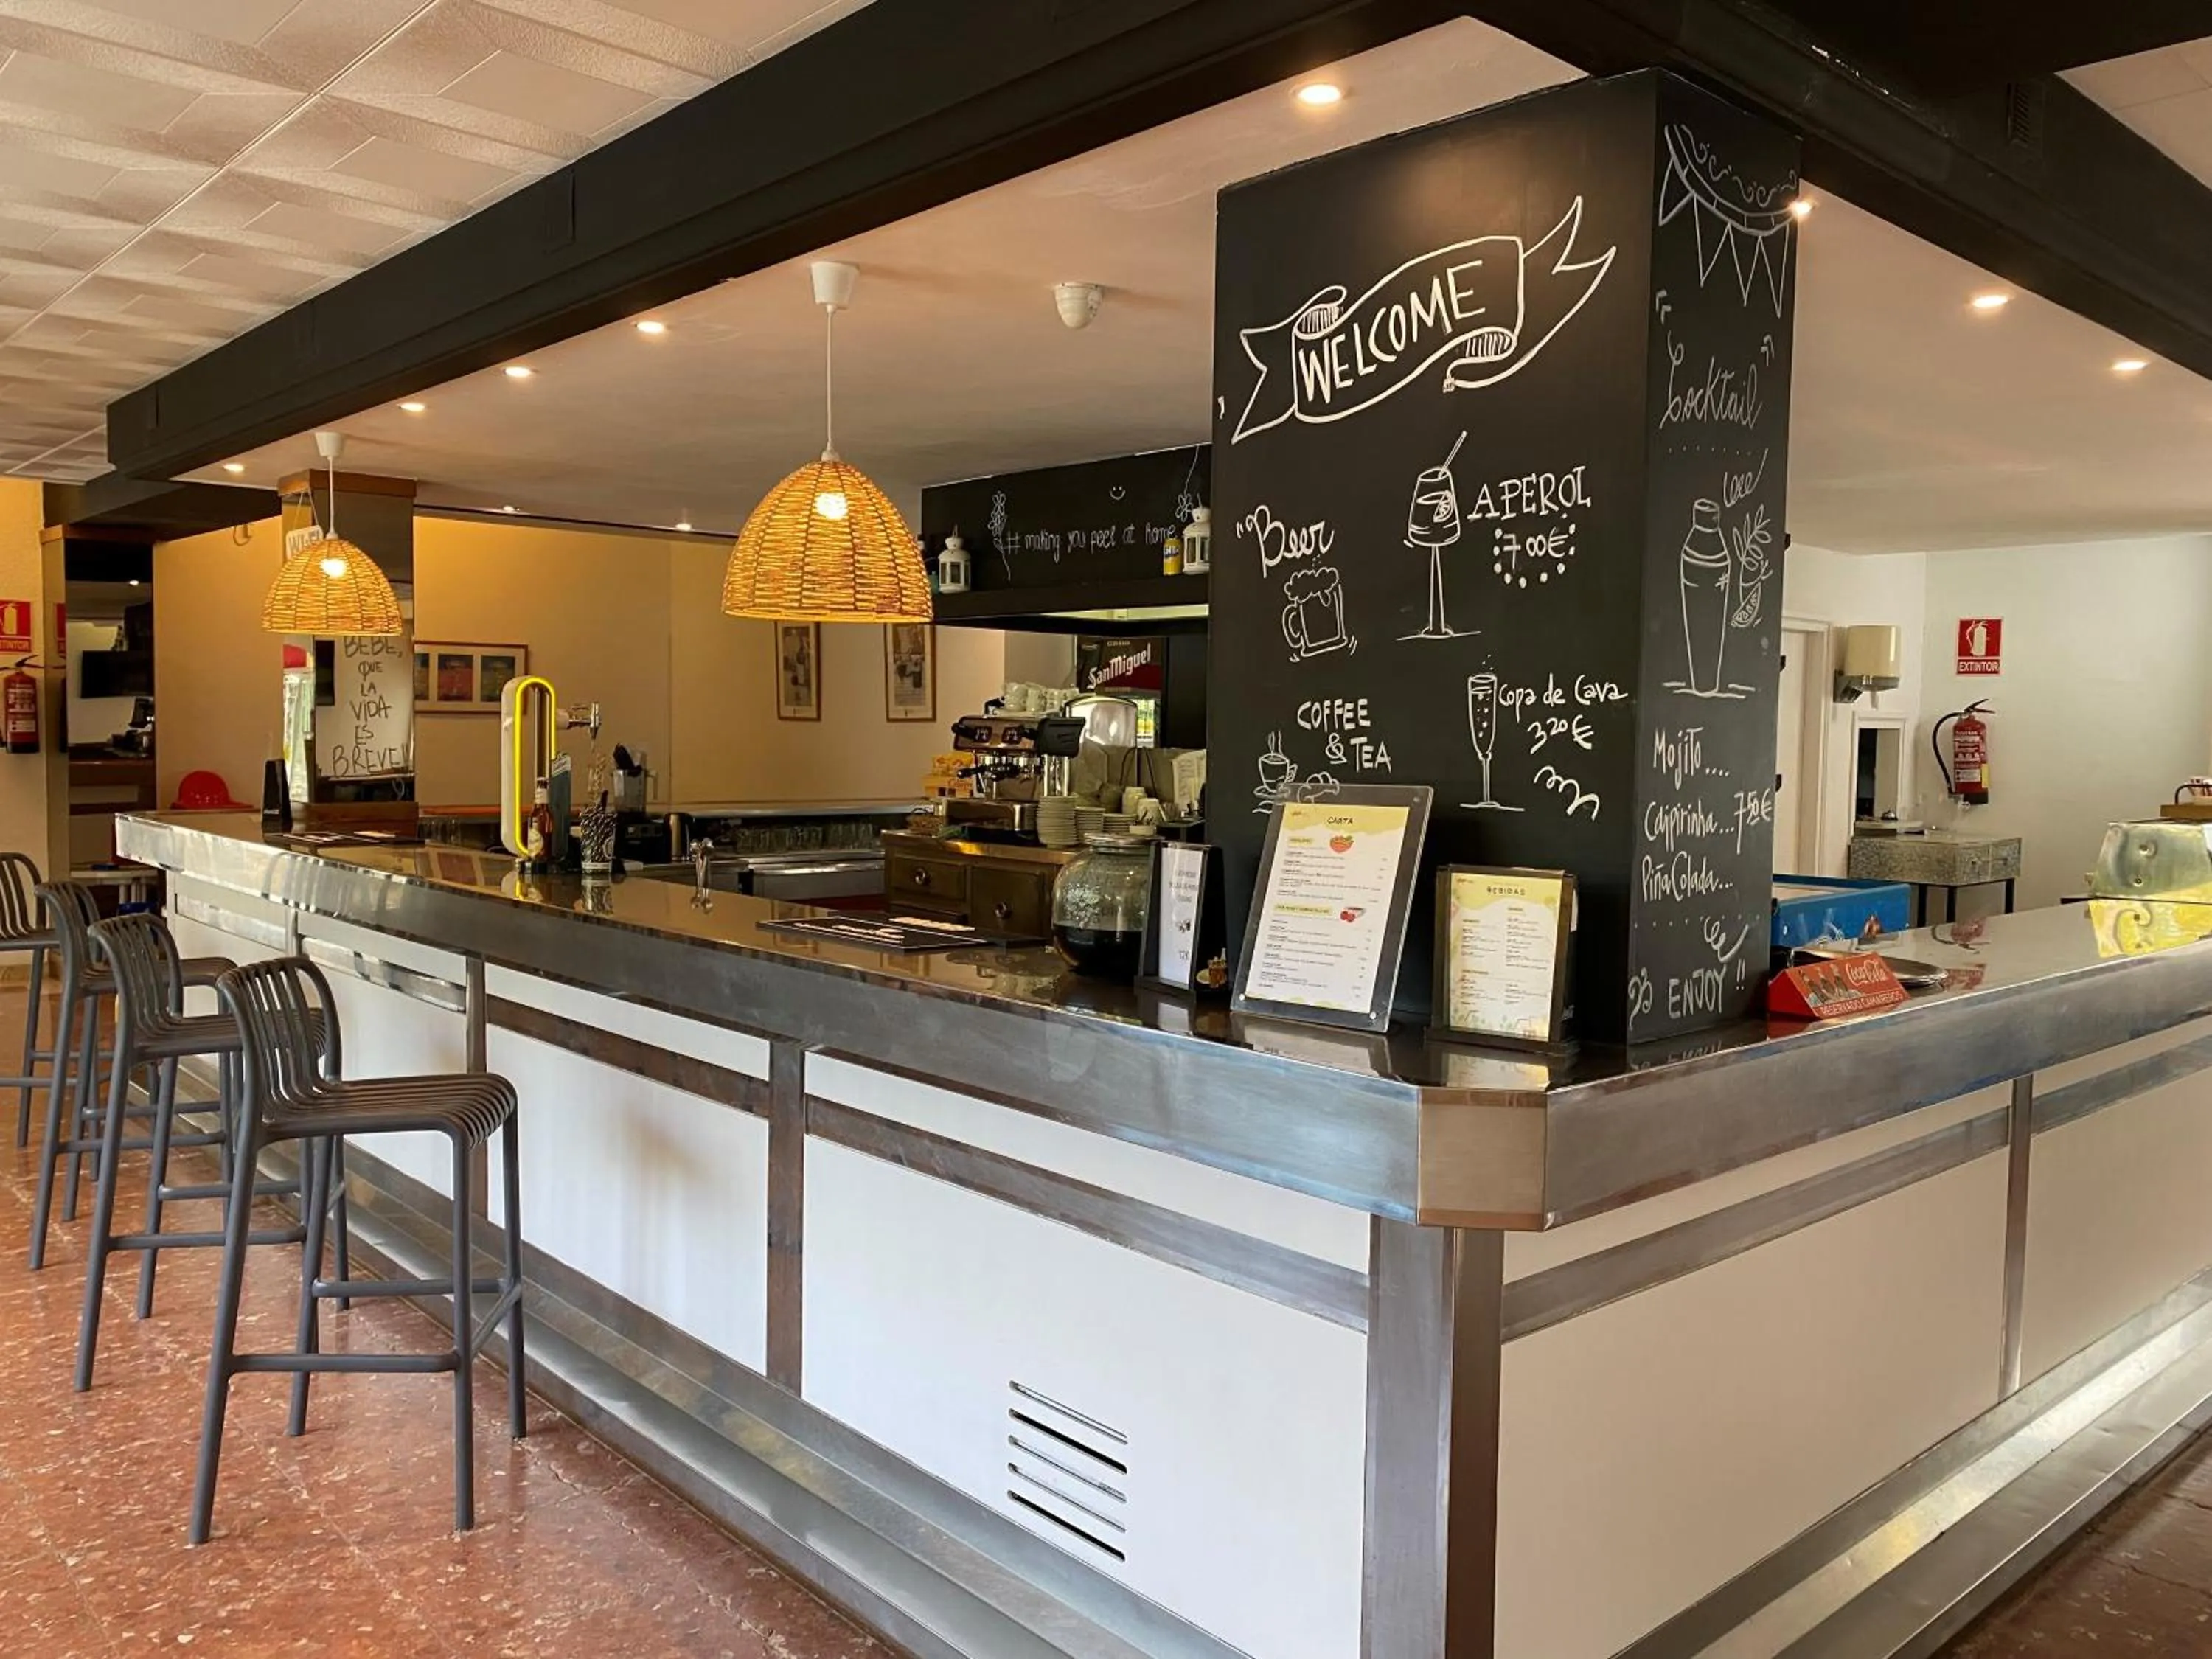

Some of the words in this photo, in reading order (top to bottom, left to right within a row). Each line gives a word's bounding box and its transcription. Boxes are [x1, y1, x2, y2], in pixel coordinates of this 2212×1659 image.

[1298, 260, 1486, 404] WELCOME
[1467, 466, 1591, 520] APEROL
[358, 661, 383, 682] QUE
[1958, 661, 1999, 672] EXTINTOR
[361, 681, 377, 697] LA
[1542, 672, 1566, 707] de
[1574, 674, 1629, 706] Cava
[349, 695, 392, 723] VIDA
[1296, 698, 1371, 731] COFFEE
[355, 724, 374, 745] ES
[1325, 732, 1347, 765] &
[1350, 737, 1392, 773] TEA
[1669, 965, 1727, 1020] ENJOY
